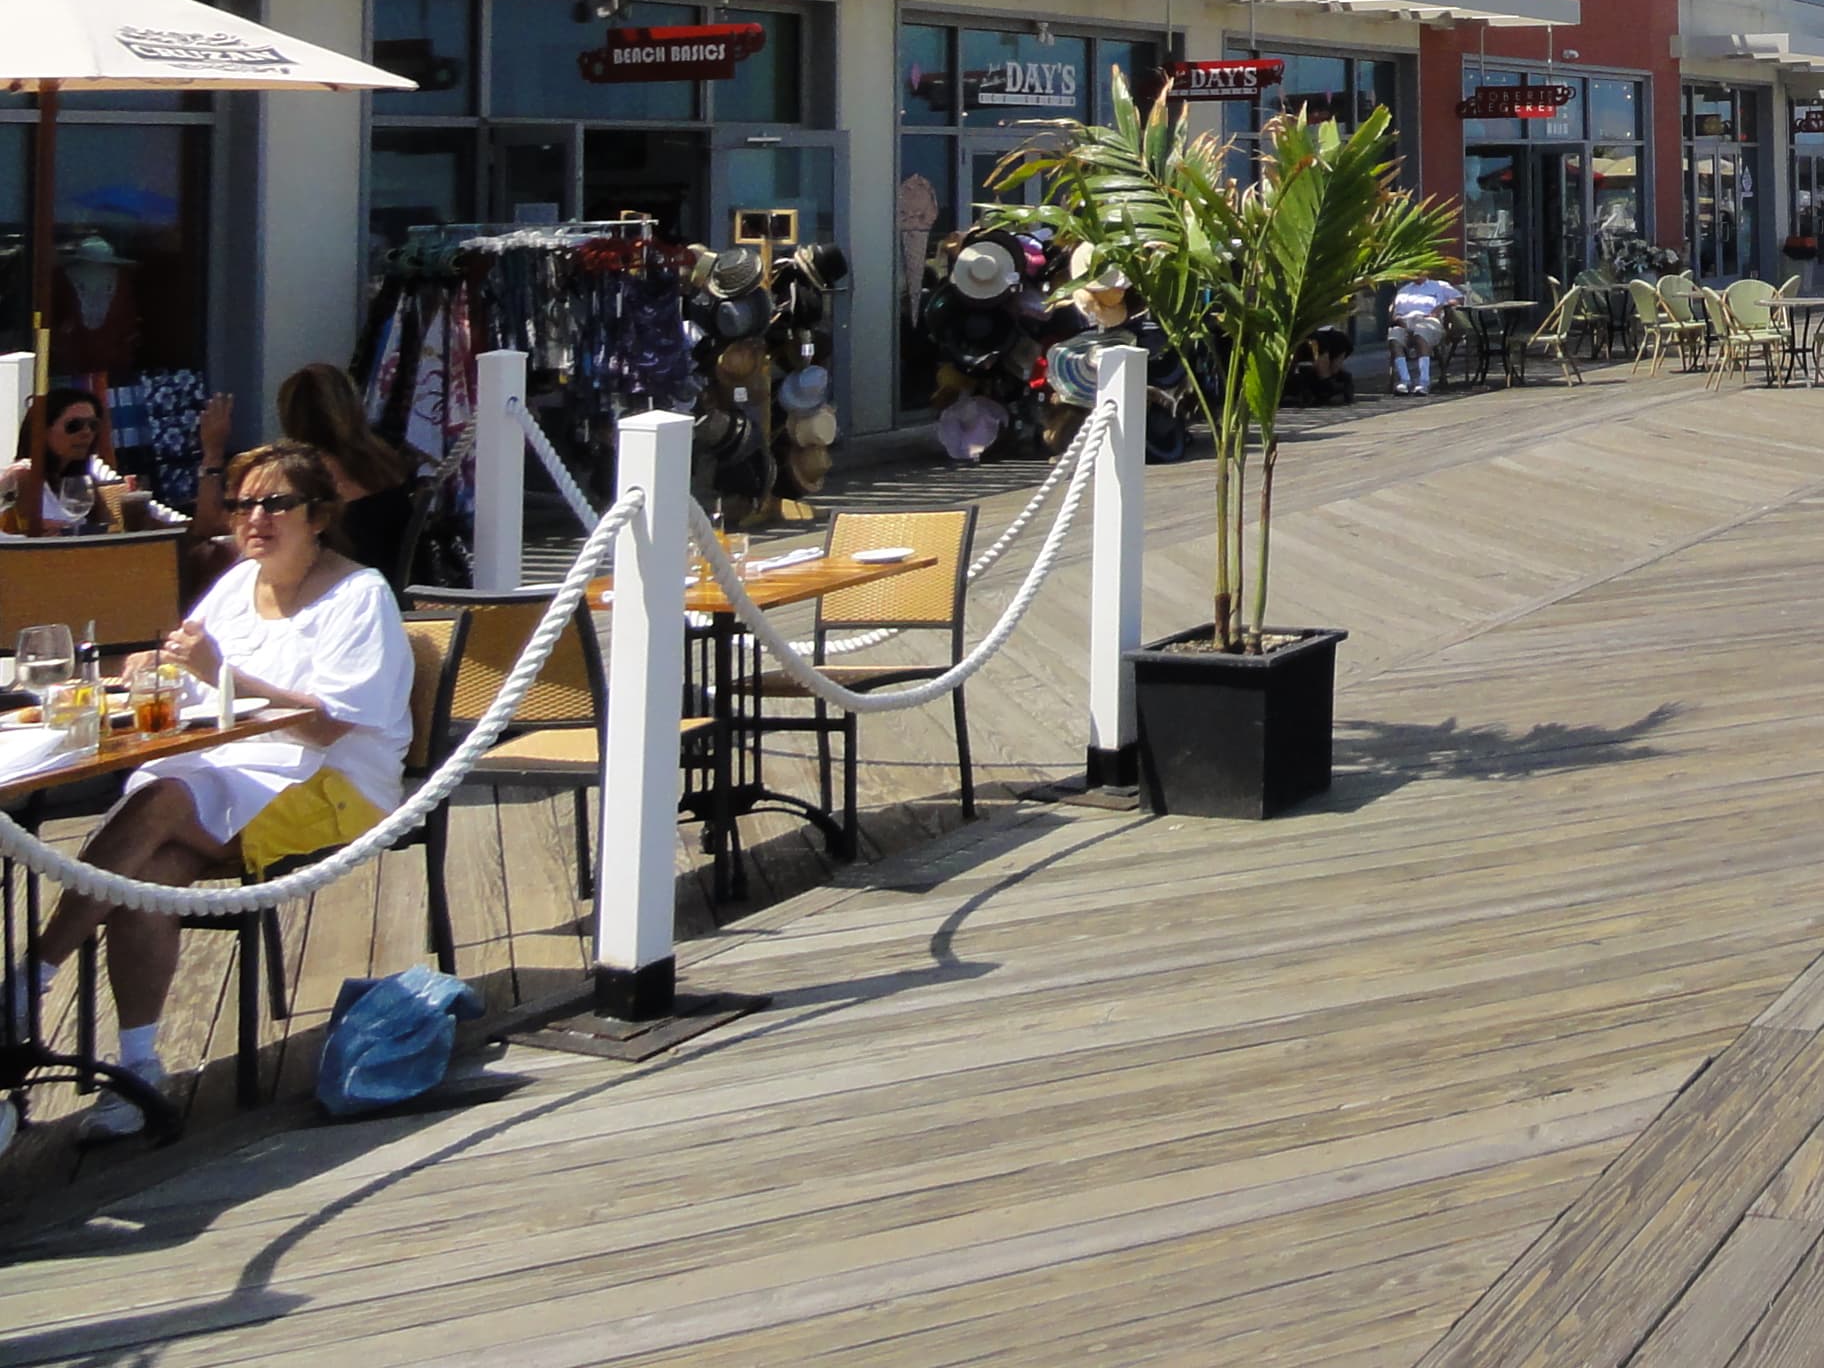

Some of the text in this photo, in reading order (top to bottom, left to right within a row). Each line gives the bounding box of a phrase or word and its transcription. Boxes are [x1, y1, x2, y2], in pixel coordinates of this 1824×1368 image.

[130, 44, 280, 62] CRUZAN
[613, 43, 726, 64] BEACH BASICS
[1005, 61, 1076, 94] DAY'S
[1191, 66, 1257, 88] DAY'S
